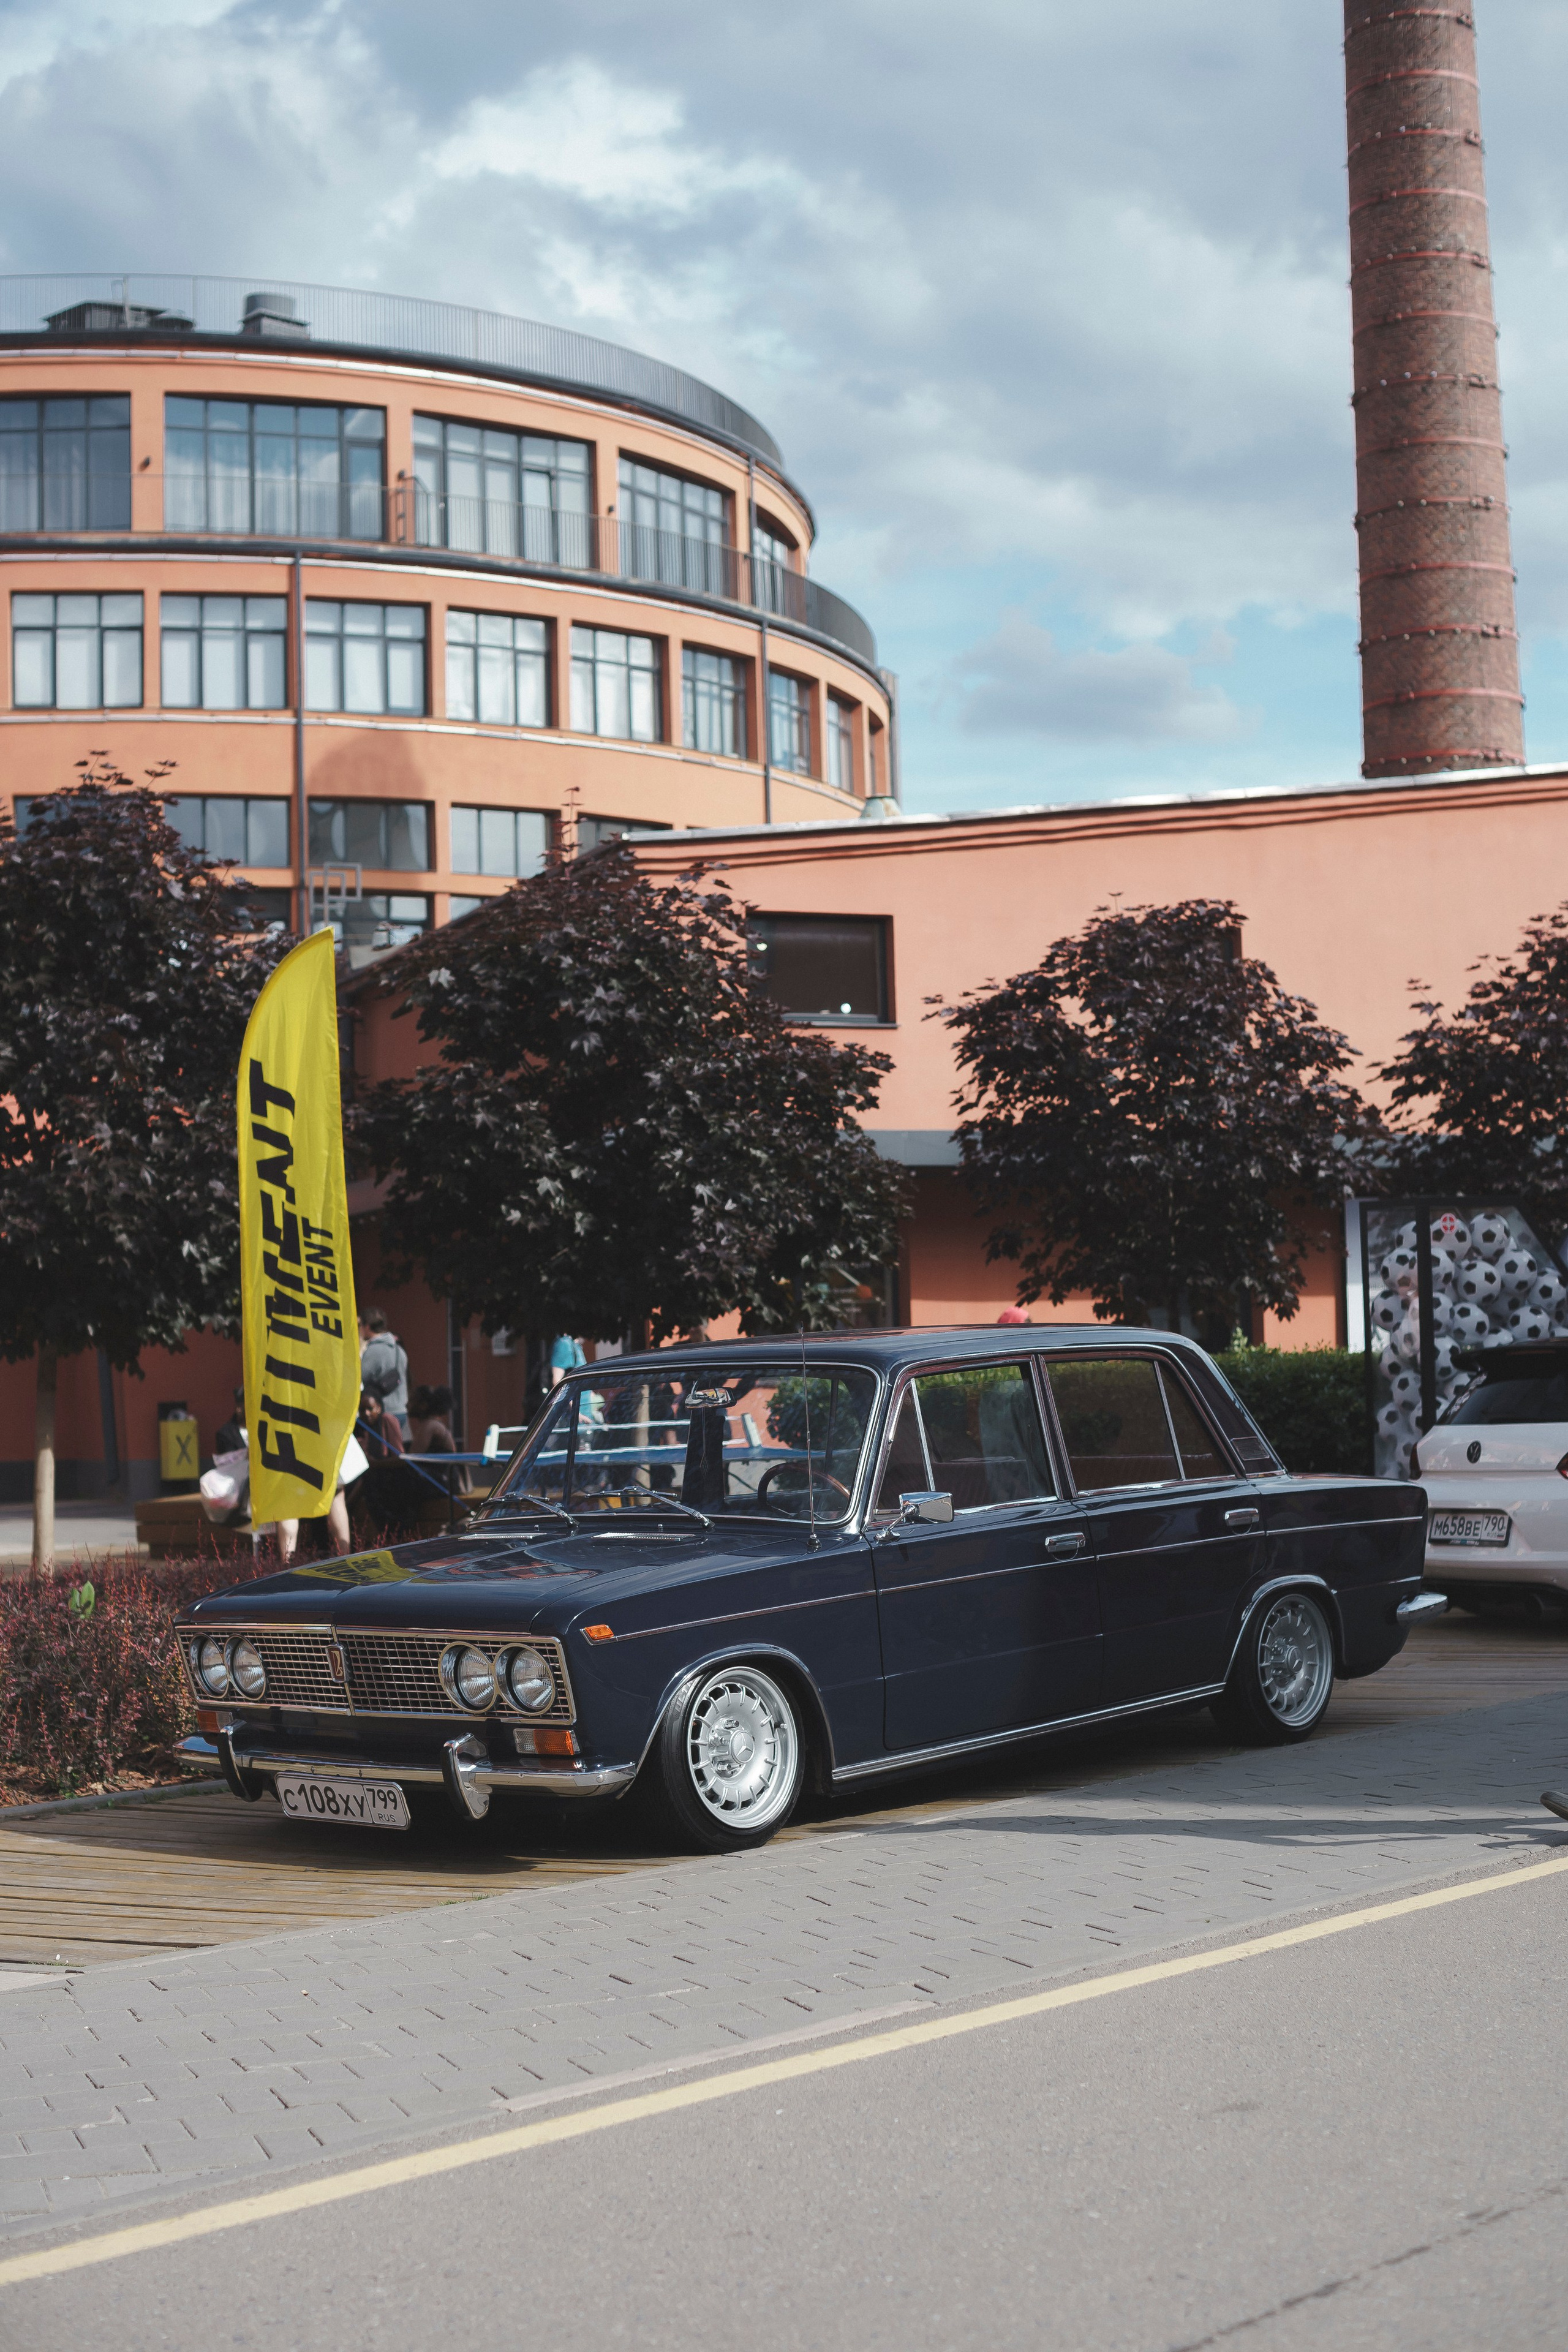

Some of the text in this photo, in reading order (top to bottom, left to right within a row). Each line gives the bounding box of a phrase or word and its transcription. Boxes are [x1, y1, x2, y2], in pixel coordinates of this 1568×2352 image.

[301, 1216, 343, 1339] EVENT
[1485, 1516, 1505, 1531] 790
[366, 1788, 398, 1810] 799
[378, 1812, 396, 1823] RUS
